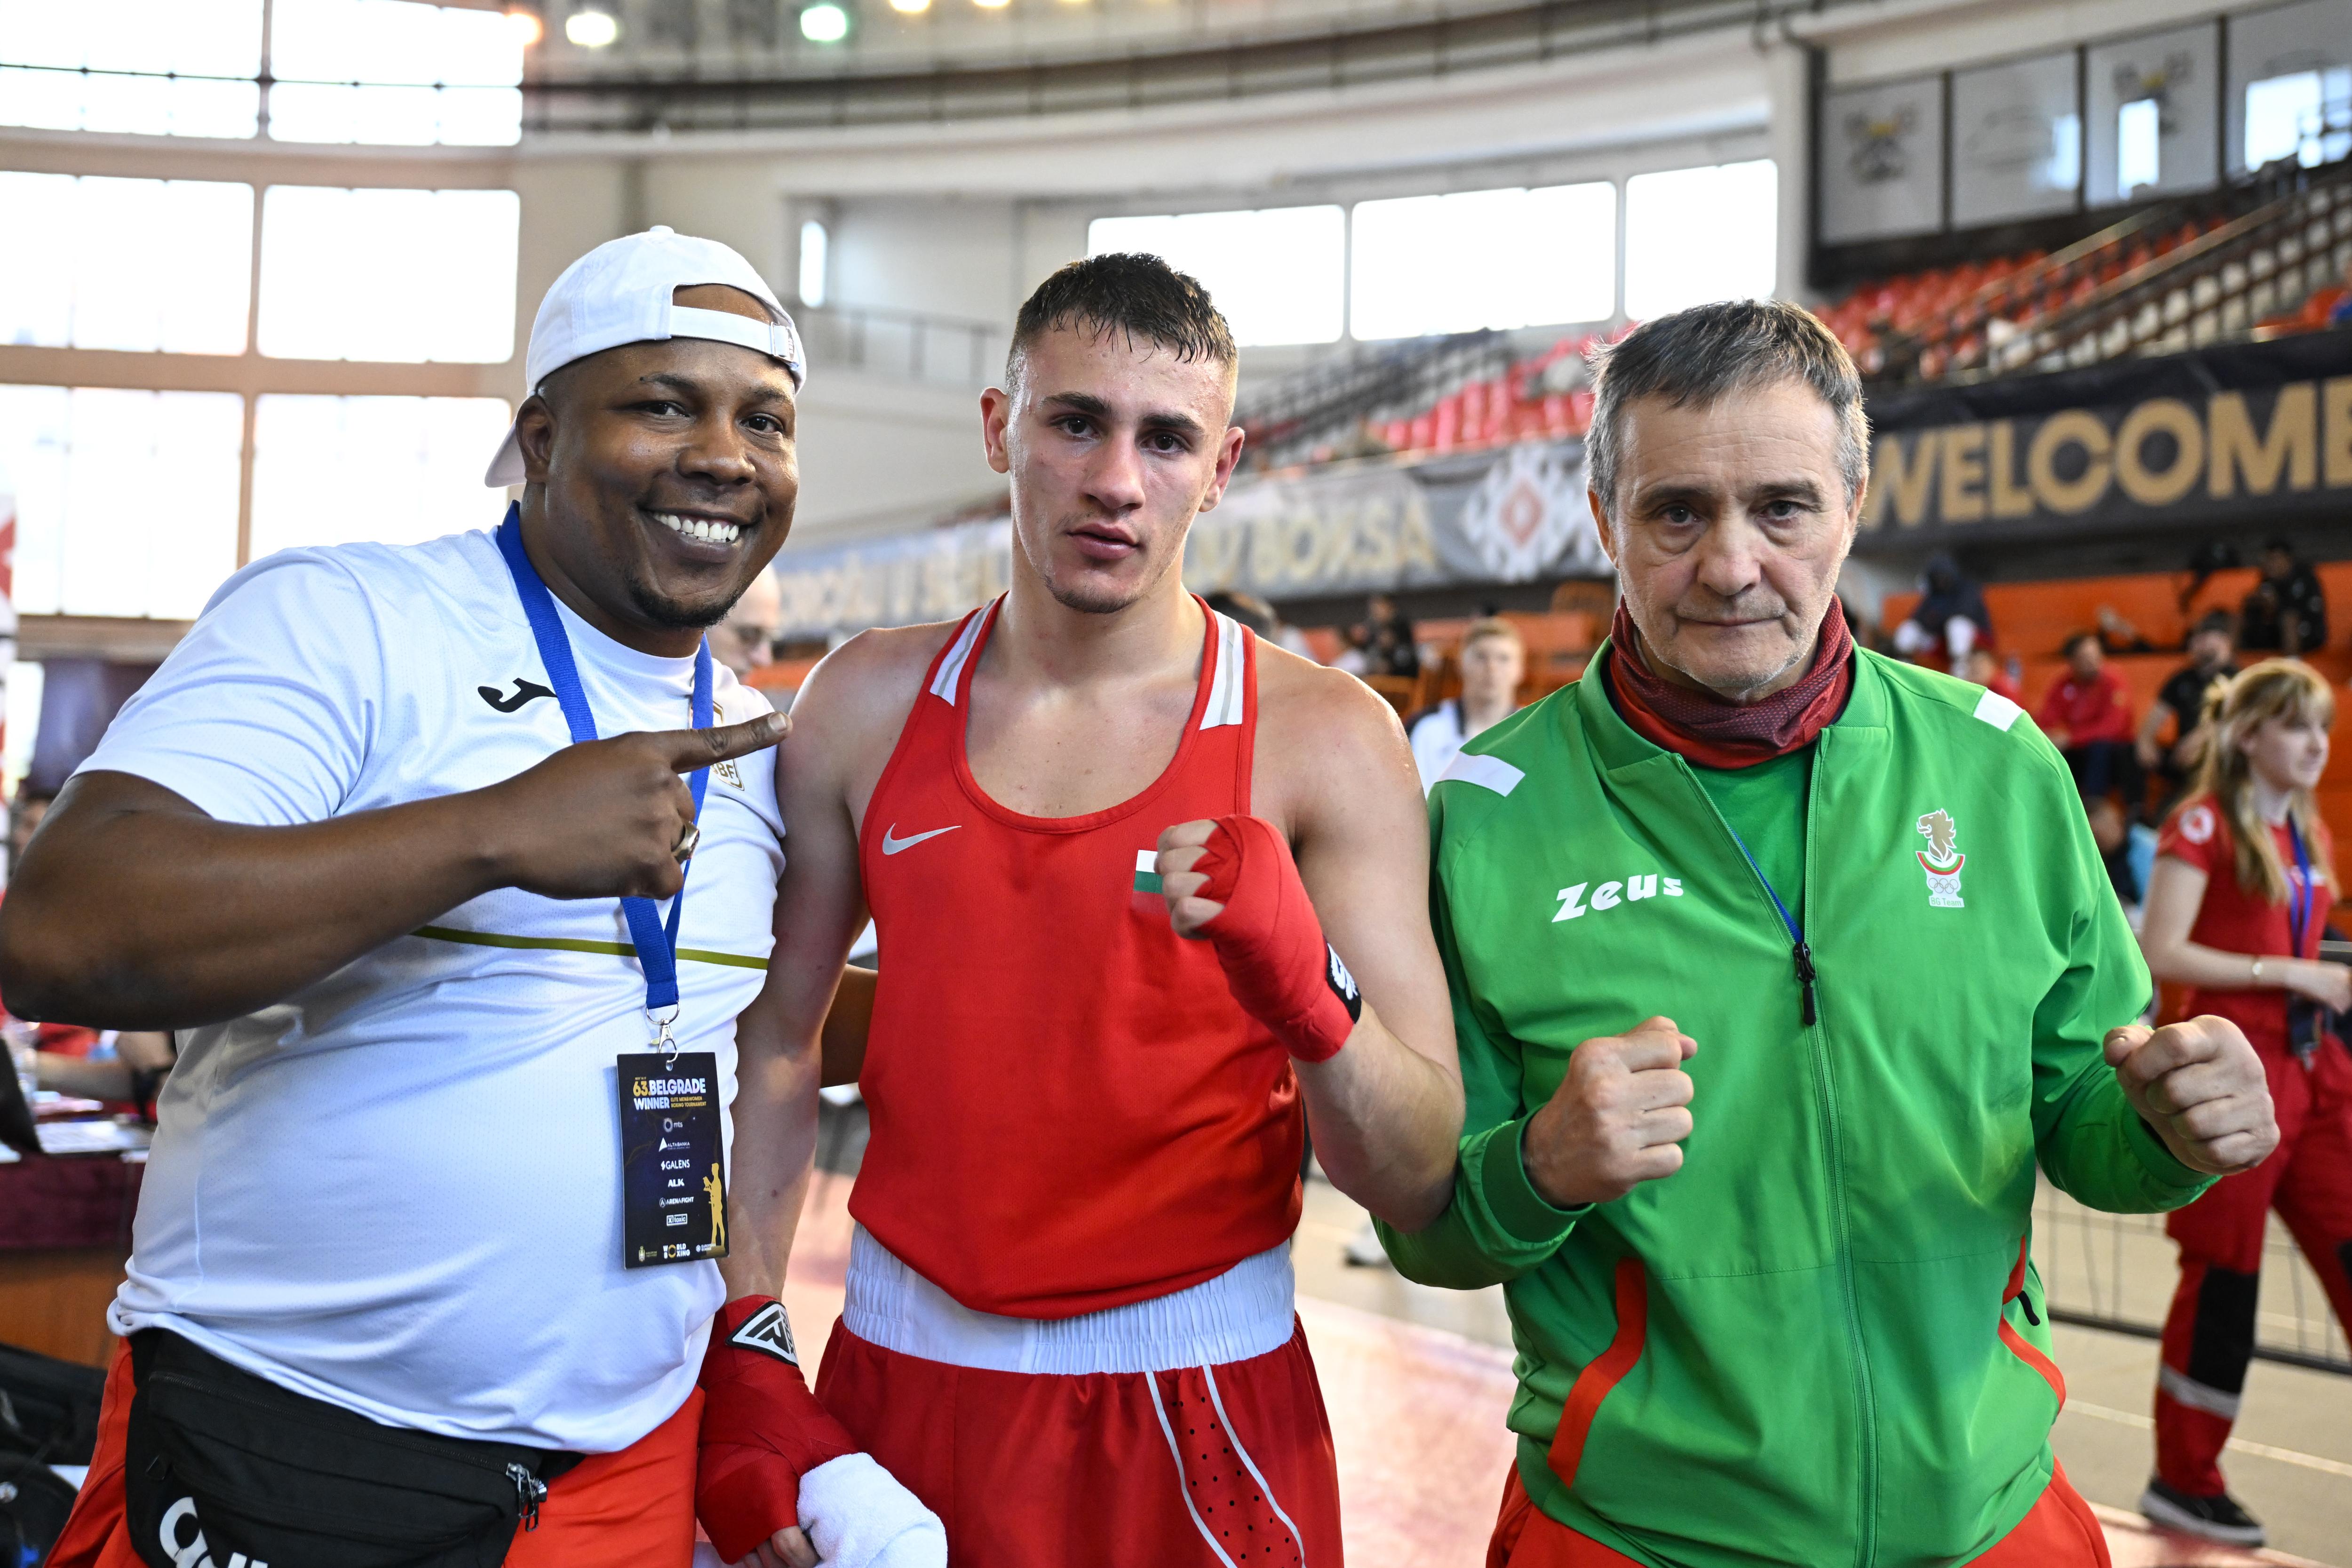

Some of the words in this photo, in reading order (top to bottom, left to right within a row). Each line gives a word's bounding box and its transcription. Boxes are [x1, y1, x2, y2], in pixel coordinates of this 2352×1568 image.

[1864, 376, 2352, 532] WELCOME
[1931, 897, 1941, 906] BG
[1942, 898, 1962, 907] Team
[634, 1097, 670, 1110] WINNER
[666, 1159, 690, 1170] GALENS
[668, 1178, 685, 1187] ALK
